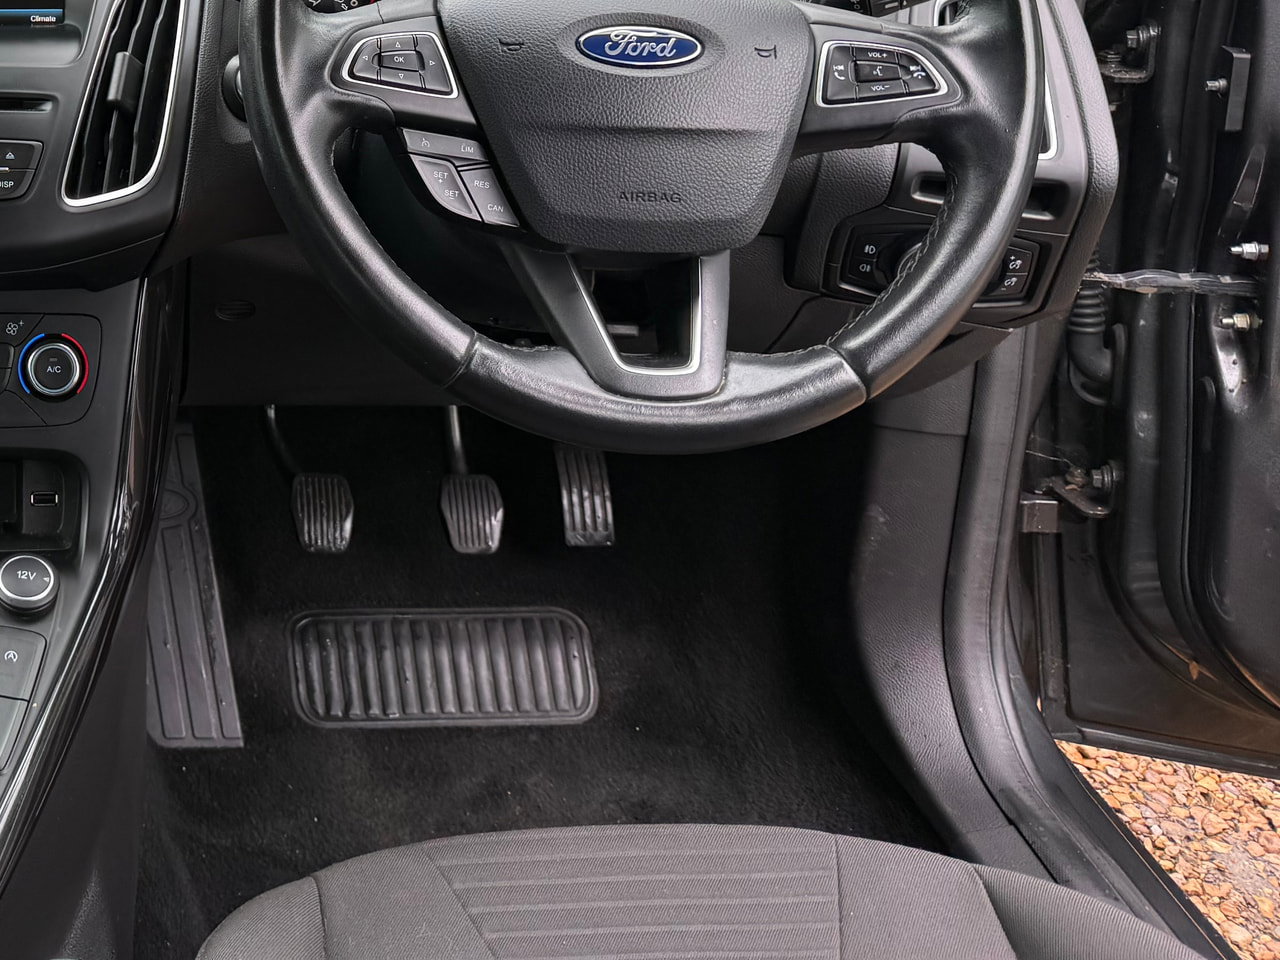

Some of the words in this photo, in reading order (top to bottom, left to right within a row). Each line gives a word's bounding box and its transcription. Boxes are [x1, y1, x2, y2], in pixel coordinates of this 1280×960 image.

[604, 28, 678, 58] Ford
[461, 144, 474, 153] LIM
[433, 171, 449, 179] SET
[474, 180, 490, 189] RES
[444, 189, 460, 198] SET
[620, 191, 683, 203] AIRBAG
[487, 203, 504, 212] CAN
[46, 364, 62, 374] A/C
[16, 570, 37, 581] 12V
